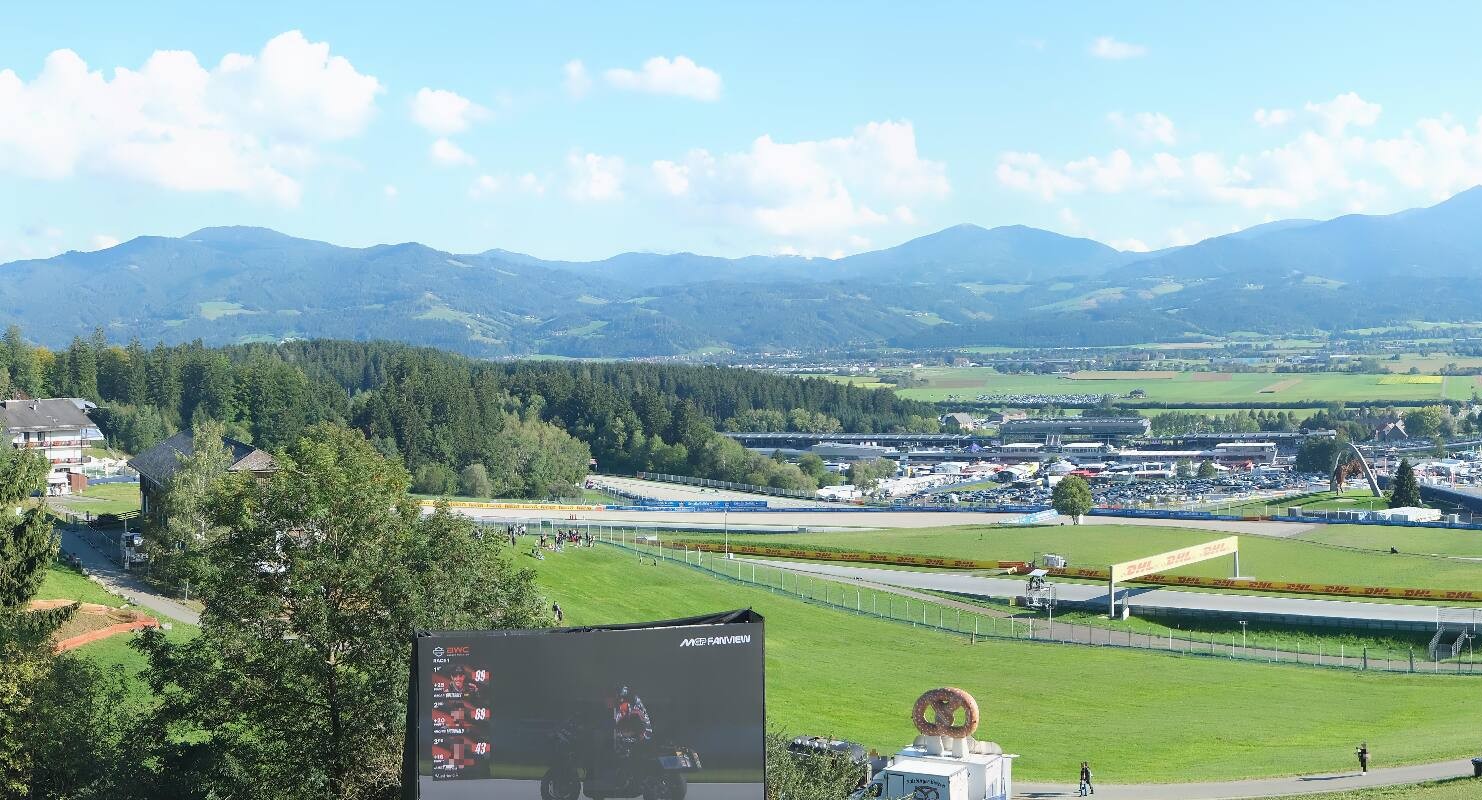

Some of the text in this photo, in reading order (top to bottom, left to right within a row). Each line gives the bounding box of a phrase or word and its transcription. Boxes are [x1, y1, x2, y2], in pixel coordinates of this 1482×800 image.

[1127, 543, 1227, 576] DHL DHL DHL
[1249, 581, 1273, 589] DHL
[1286, 583, 1313, 591] DHL
[1324, 585, 1351, 593] DHL
[1363, 587, 1391, 595] DHL
[707, 635, 751, 645] FANVIEW
[475, 670, 486, 682] 99
[475, 742, 487, 755] 43
